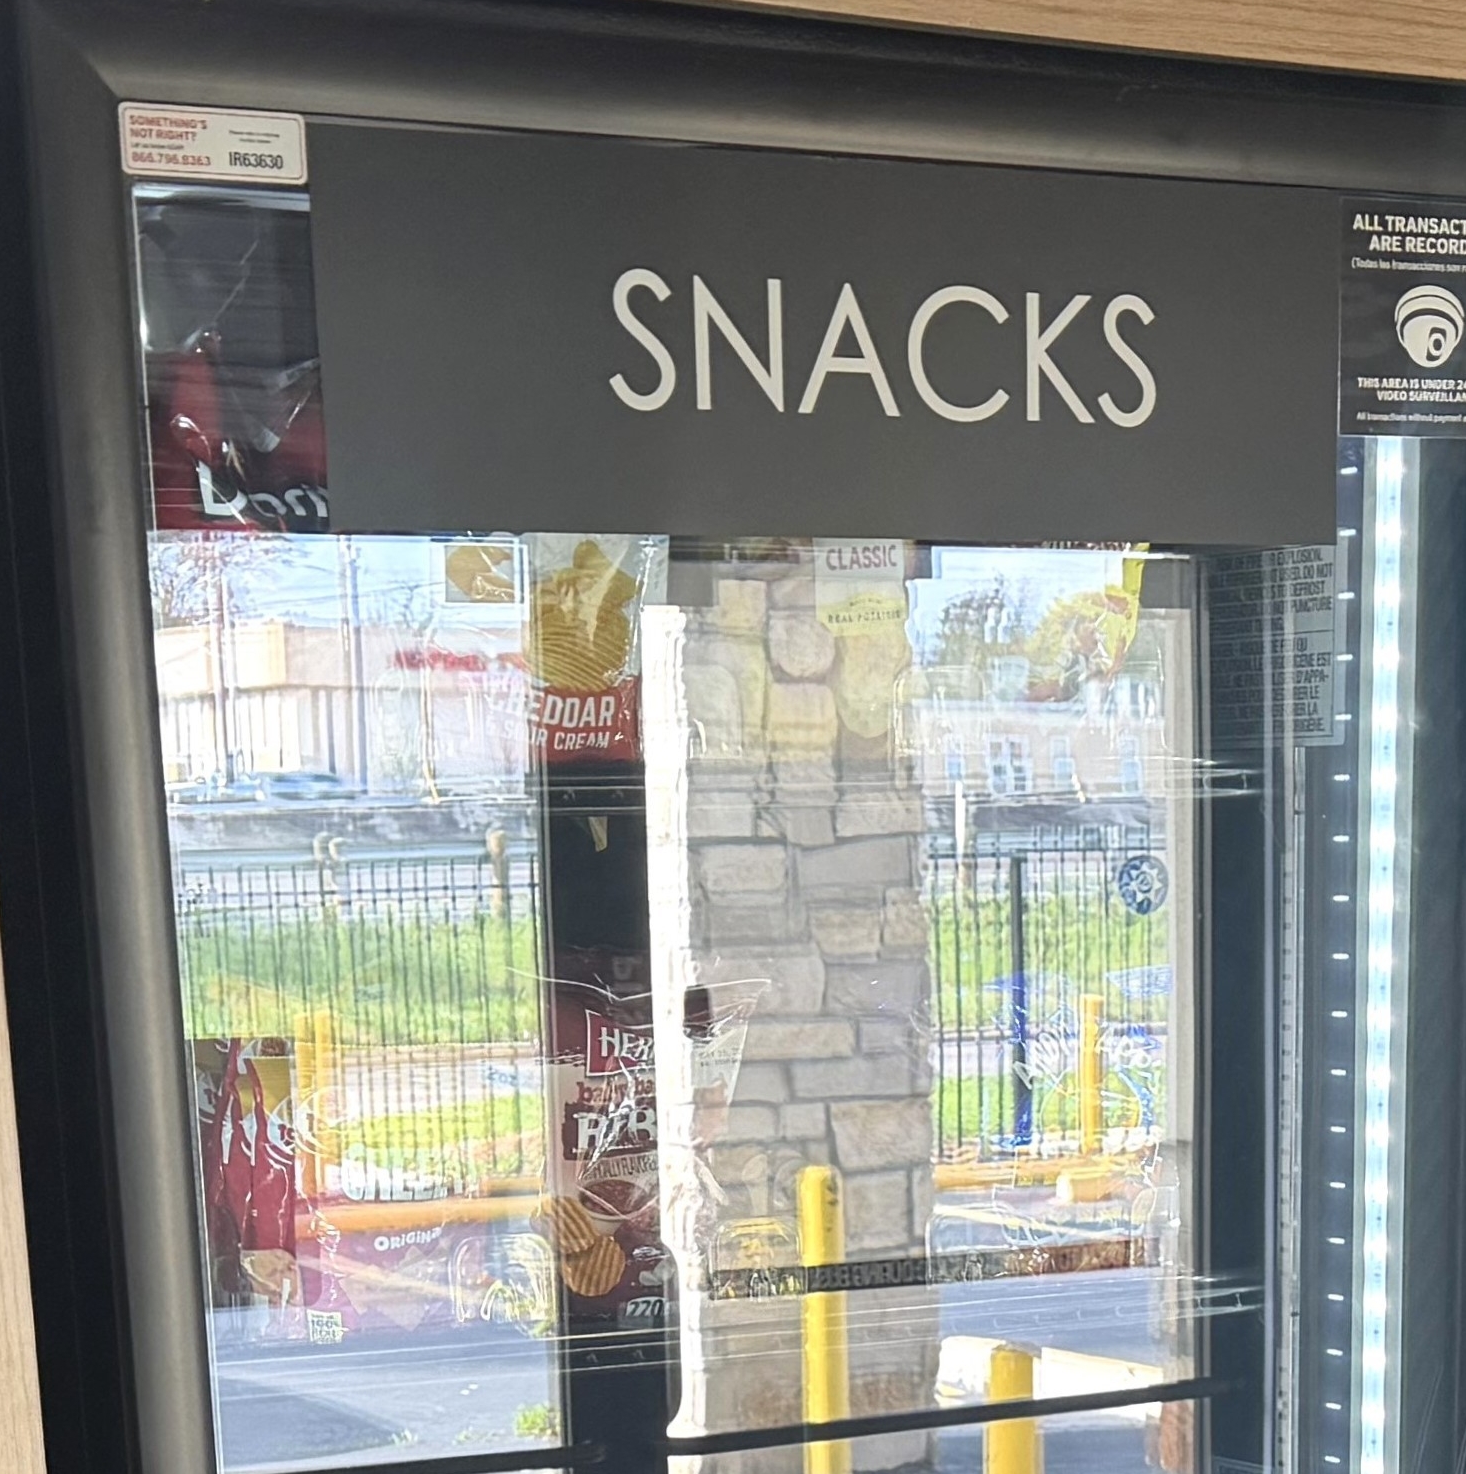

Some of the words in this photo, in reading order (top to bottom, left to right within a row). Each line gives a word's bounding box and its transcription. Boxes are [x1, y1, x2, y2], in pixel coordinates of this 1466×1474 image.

[130, 115, 207, 129] SOMETHING'S
[130, 129, 152, 139] NOT
[155, 131, 197, 141] RIGHT?
[229, 152, 284, 169] IR63630
[1353, 214, 1383, 231] ALL
[1369, 236, 1403, 251] ARE
[609, 268, 1156, 428] SNACKS
[1357, 377, 1380, 388] THIS
[1381, 378, 1408, 389] AREA
[1409, 379, 1419, 389] IS
[1421, 379, 1455, 390] UNDER
[1377, 390, 1407, 401] VIDEO
[826, 545, 897, 571] CLASSIC
[554, 731, 611, 750] CREAM
